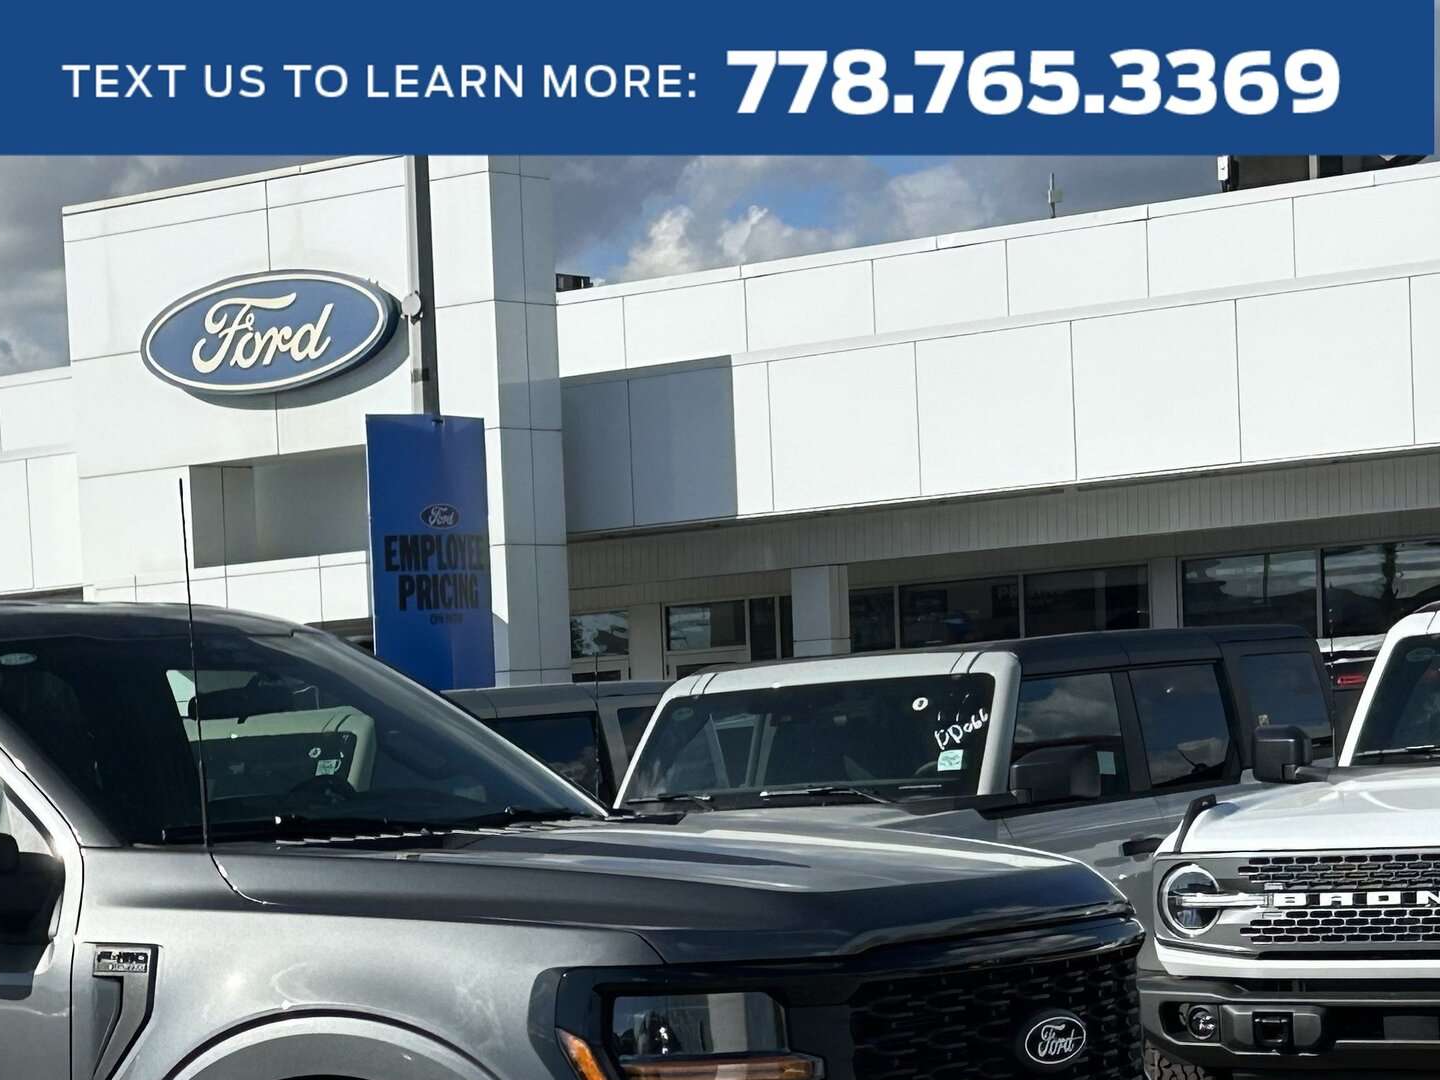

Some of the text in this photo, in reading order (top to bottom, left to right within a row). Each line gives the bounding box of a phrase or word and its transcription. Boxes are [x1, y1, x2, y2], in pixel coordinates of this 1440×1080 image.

[191, 292, 335, 374] Ford
[428, 505, 455, 528] Ford
[383, 534, 485, 572] EMPLOYEE
[398, 574, 480, 612] PRICING
[1037, 1023, 1083, 1058] Ford
